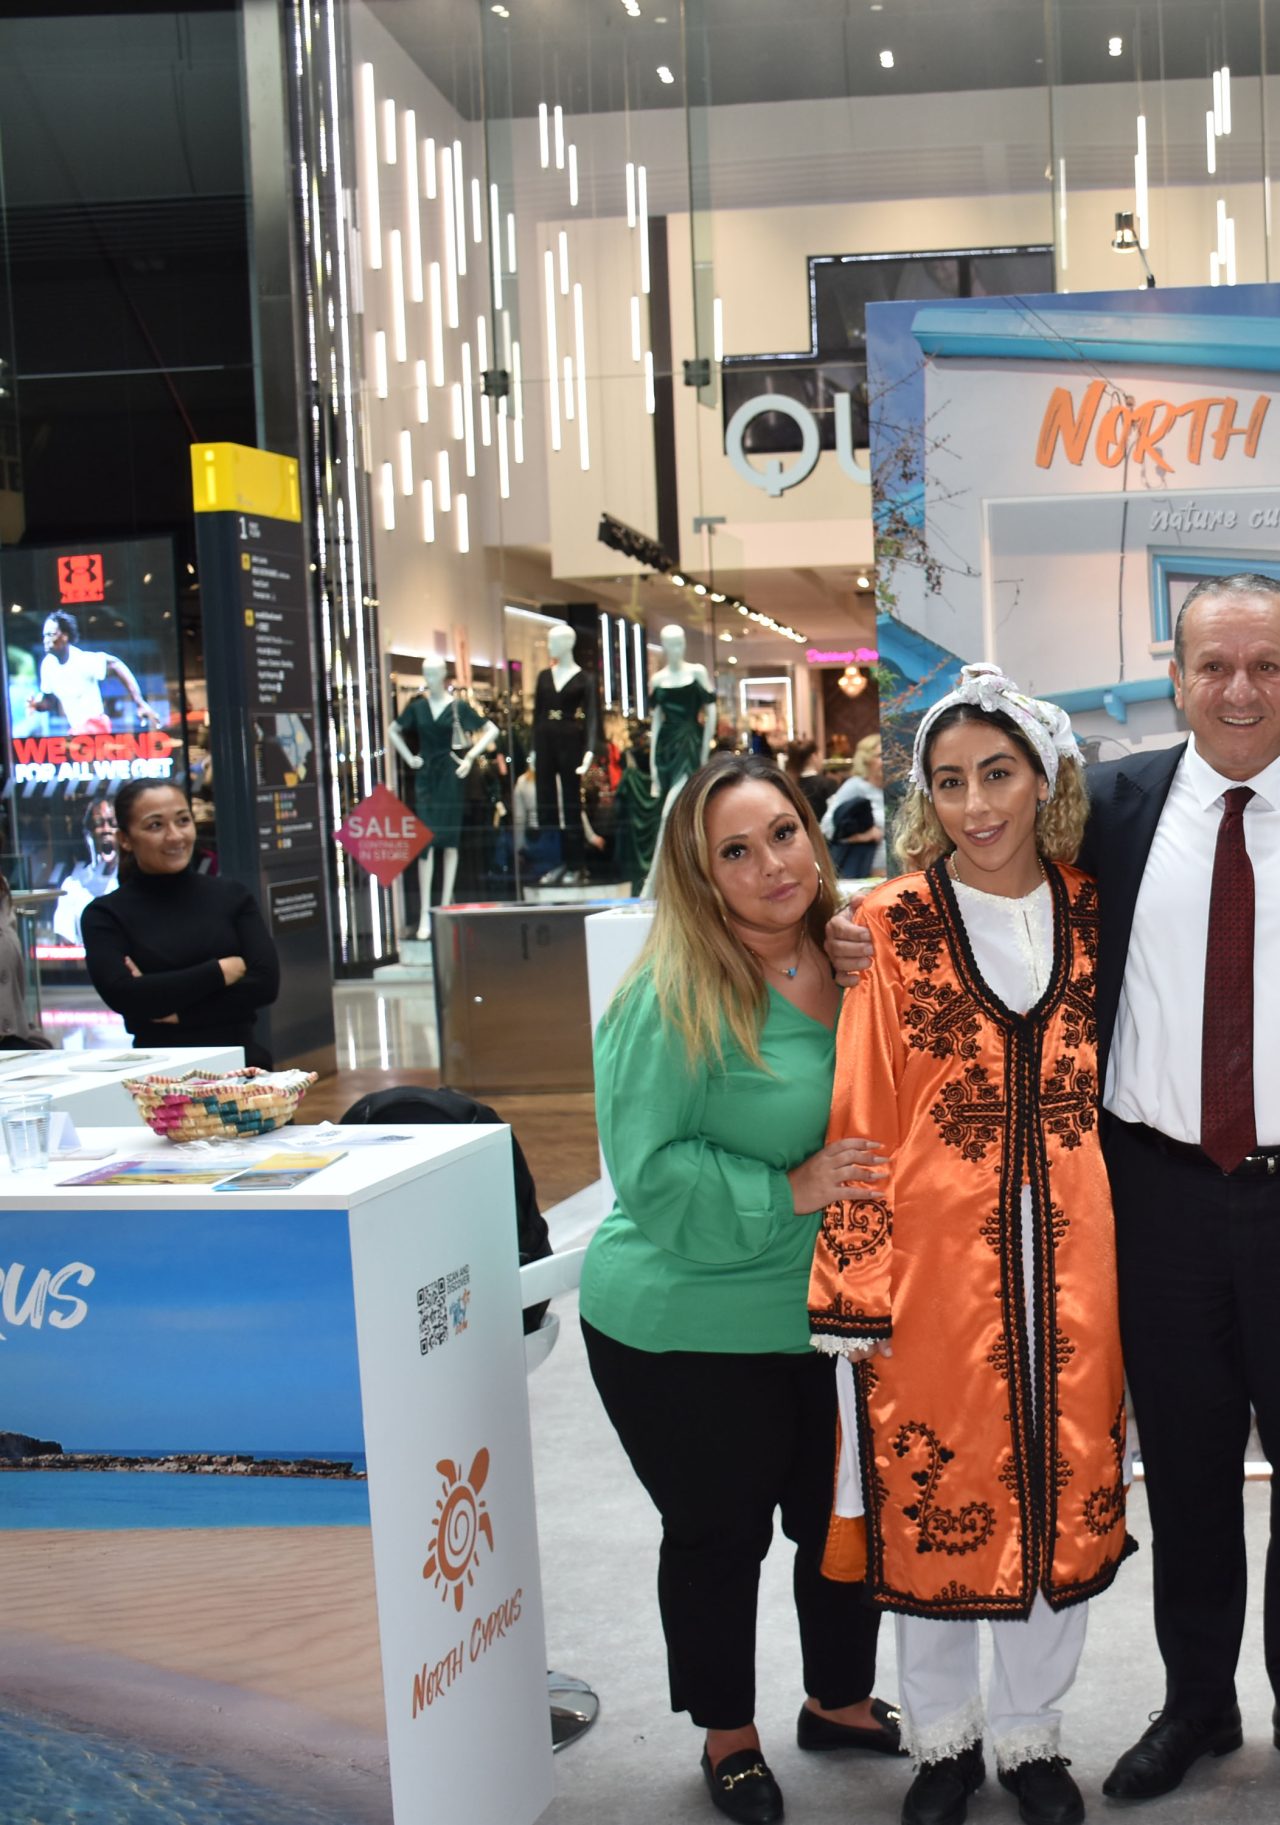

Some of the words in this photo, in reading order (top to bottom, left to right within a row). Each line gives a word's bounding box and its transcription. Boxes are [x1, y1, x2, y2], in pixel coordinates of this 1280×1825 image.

[1035, 379, 1271, 473] NORTH
[1150, 501, 1239, 532] nature
[13, 737, 67, 764] WE
[69, 731, 174, 763] GRIND
[15, 762, 56, 783] FOR
[57, 761, 94, 782] ALL
[93, 759, 131, 780] WE
[131, 757, 174, 779] GET
[348, 815, 417, 838] SALE
[412, 1640, 464, 1720] NORTH
[470, 1587, 522, 1662] CYPRUS
